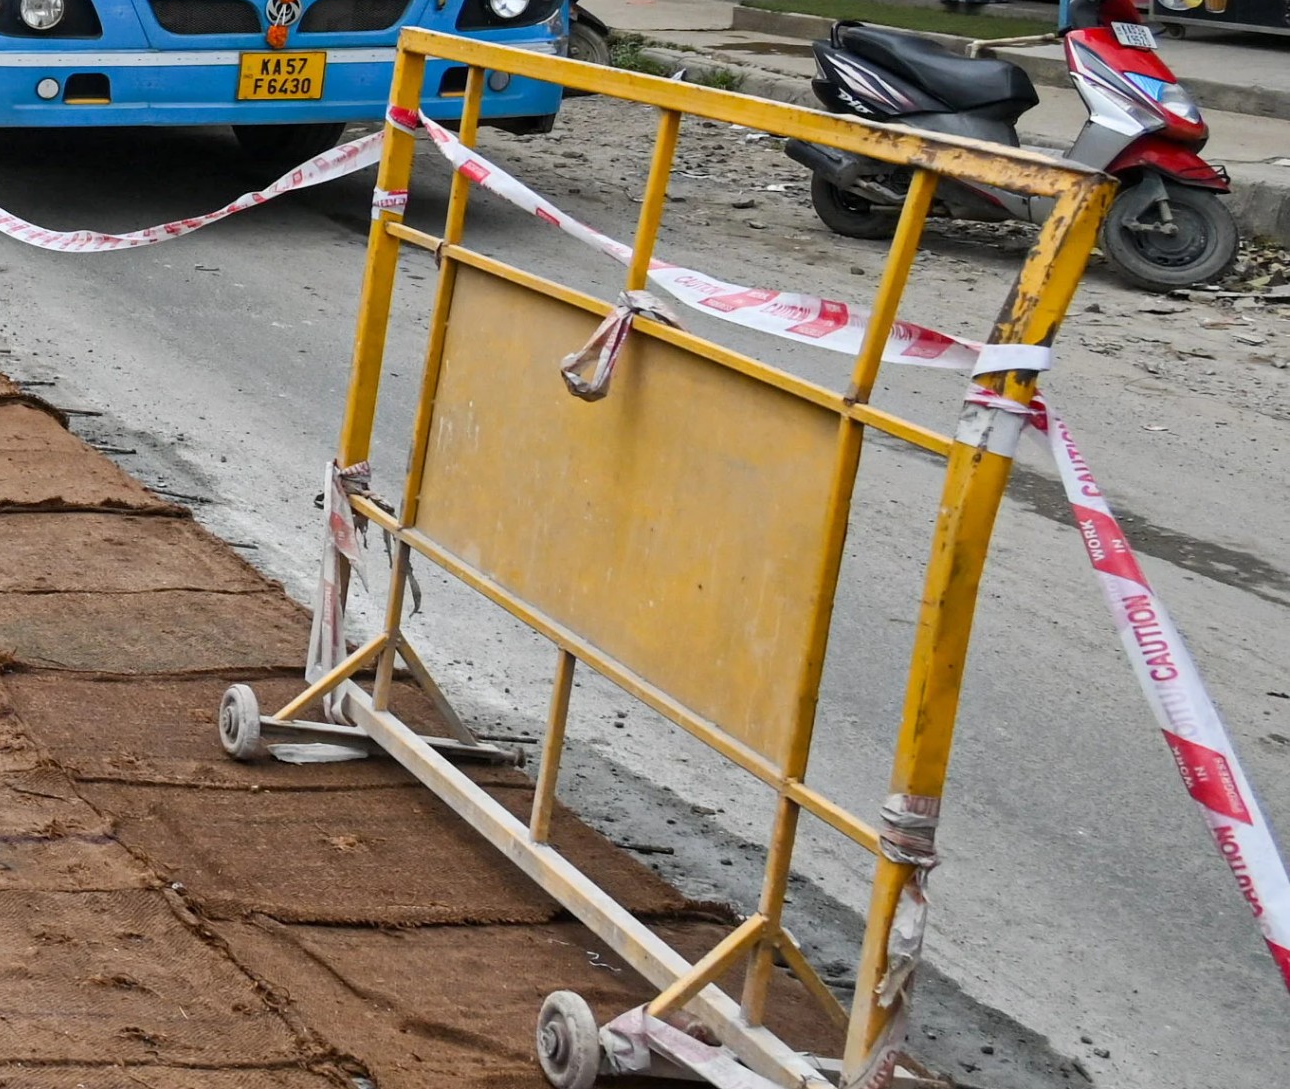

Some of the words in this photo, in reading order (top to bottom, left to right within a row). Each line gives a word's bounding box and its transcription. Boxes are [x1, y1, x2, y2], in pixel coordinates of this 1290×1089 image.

[1081, 519, 1101, 561] WORK
[1113, 538, 1125, 554] IN
[1126, 595, 1179, 683] CAUTION
[1196, 766, 1209, 784] IN
[1214, 825, 1264, 918] CAUTION
